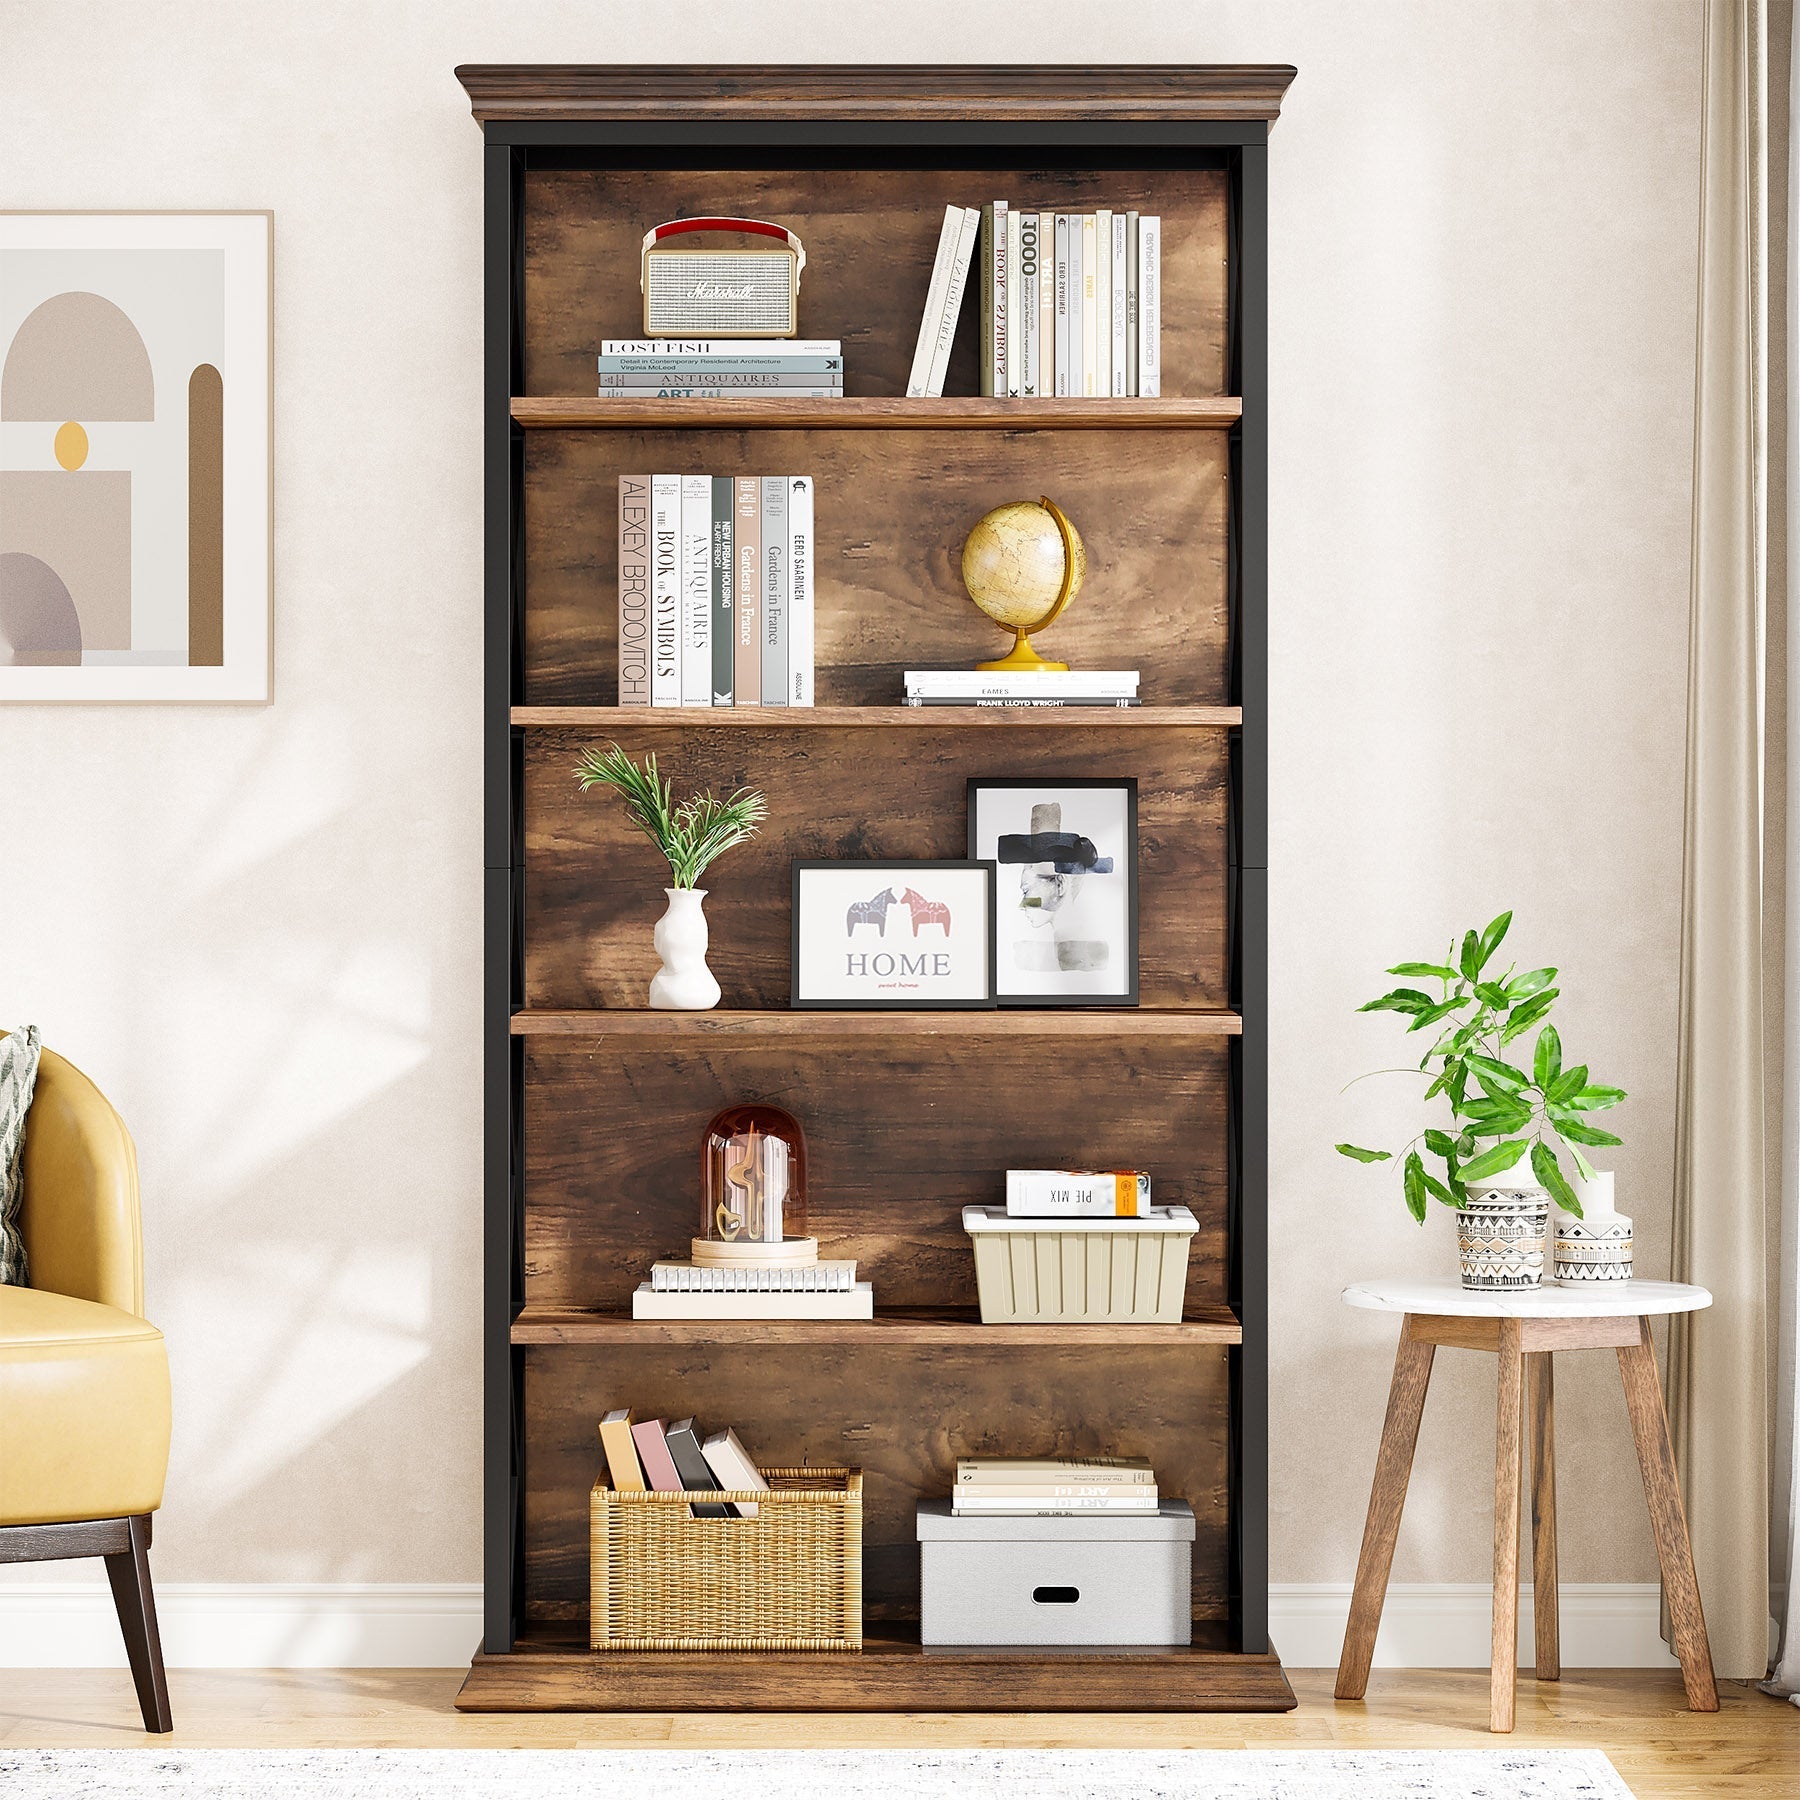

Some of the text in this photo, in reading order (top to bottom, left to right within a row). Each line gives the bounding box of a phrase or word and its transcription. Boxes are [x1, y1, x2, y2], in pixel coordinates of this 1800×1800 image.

[687, 282, 753, 299] Marshall
[609, 343, 709, 353] LOST FISH
[661, 375, 780, 383] ANTIQUAIRES
[657, 389, 694, 398] ART
[657, 511, 666, 526] THE
[714, 521, 722, 544] HILARY
[657, 531, 675, 576] BOOK
[721, 521, 732, 609] NEW URBAN HOUSING
[794, 534, 804, 601] EERO SAARINEN
[622, 480, 647, 694] ALEXEY BRODOVITCH
[657, 580, 666, 592] OF
[690, 534, 708, 649] ANTIQUAIRES
[741, 545, 755, 646] Gardens in France
[768, 546, 781, 646] Gardens in France
[657, 595, 675, 677] SYMBOLS
[846, 953, 951, 976] HOME
[1050, 1190, 1092, 1203] PIE MIX
[1077, 1486, 1110, 1497] ART
[1078, 1499, 1109, 1507] ART
